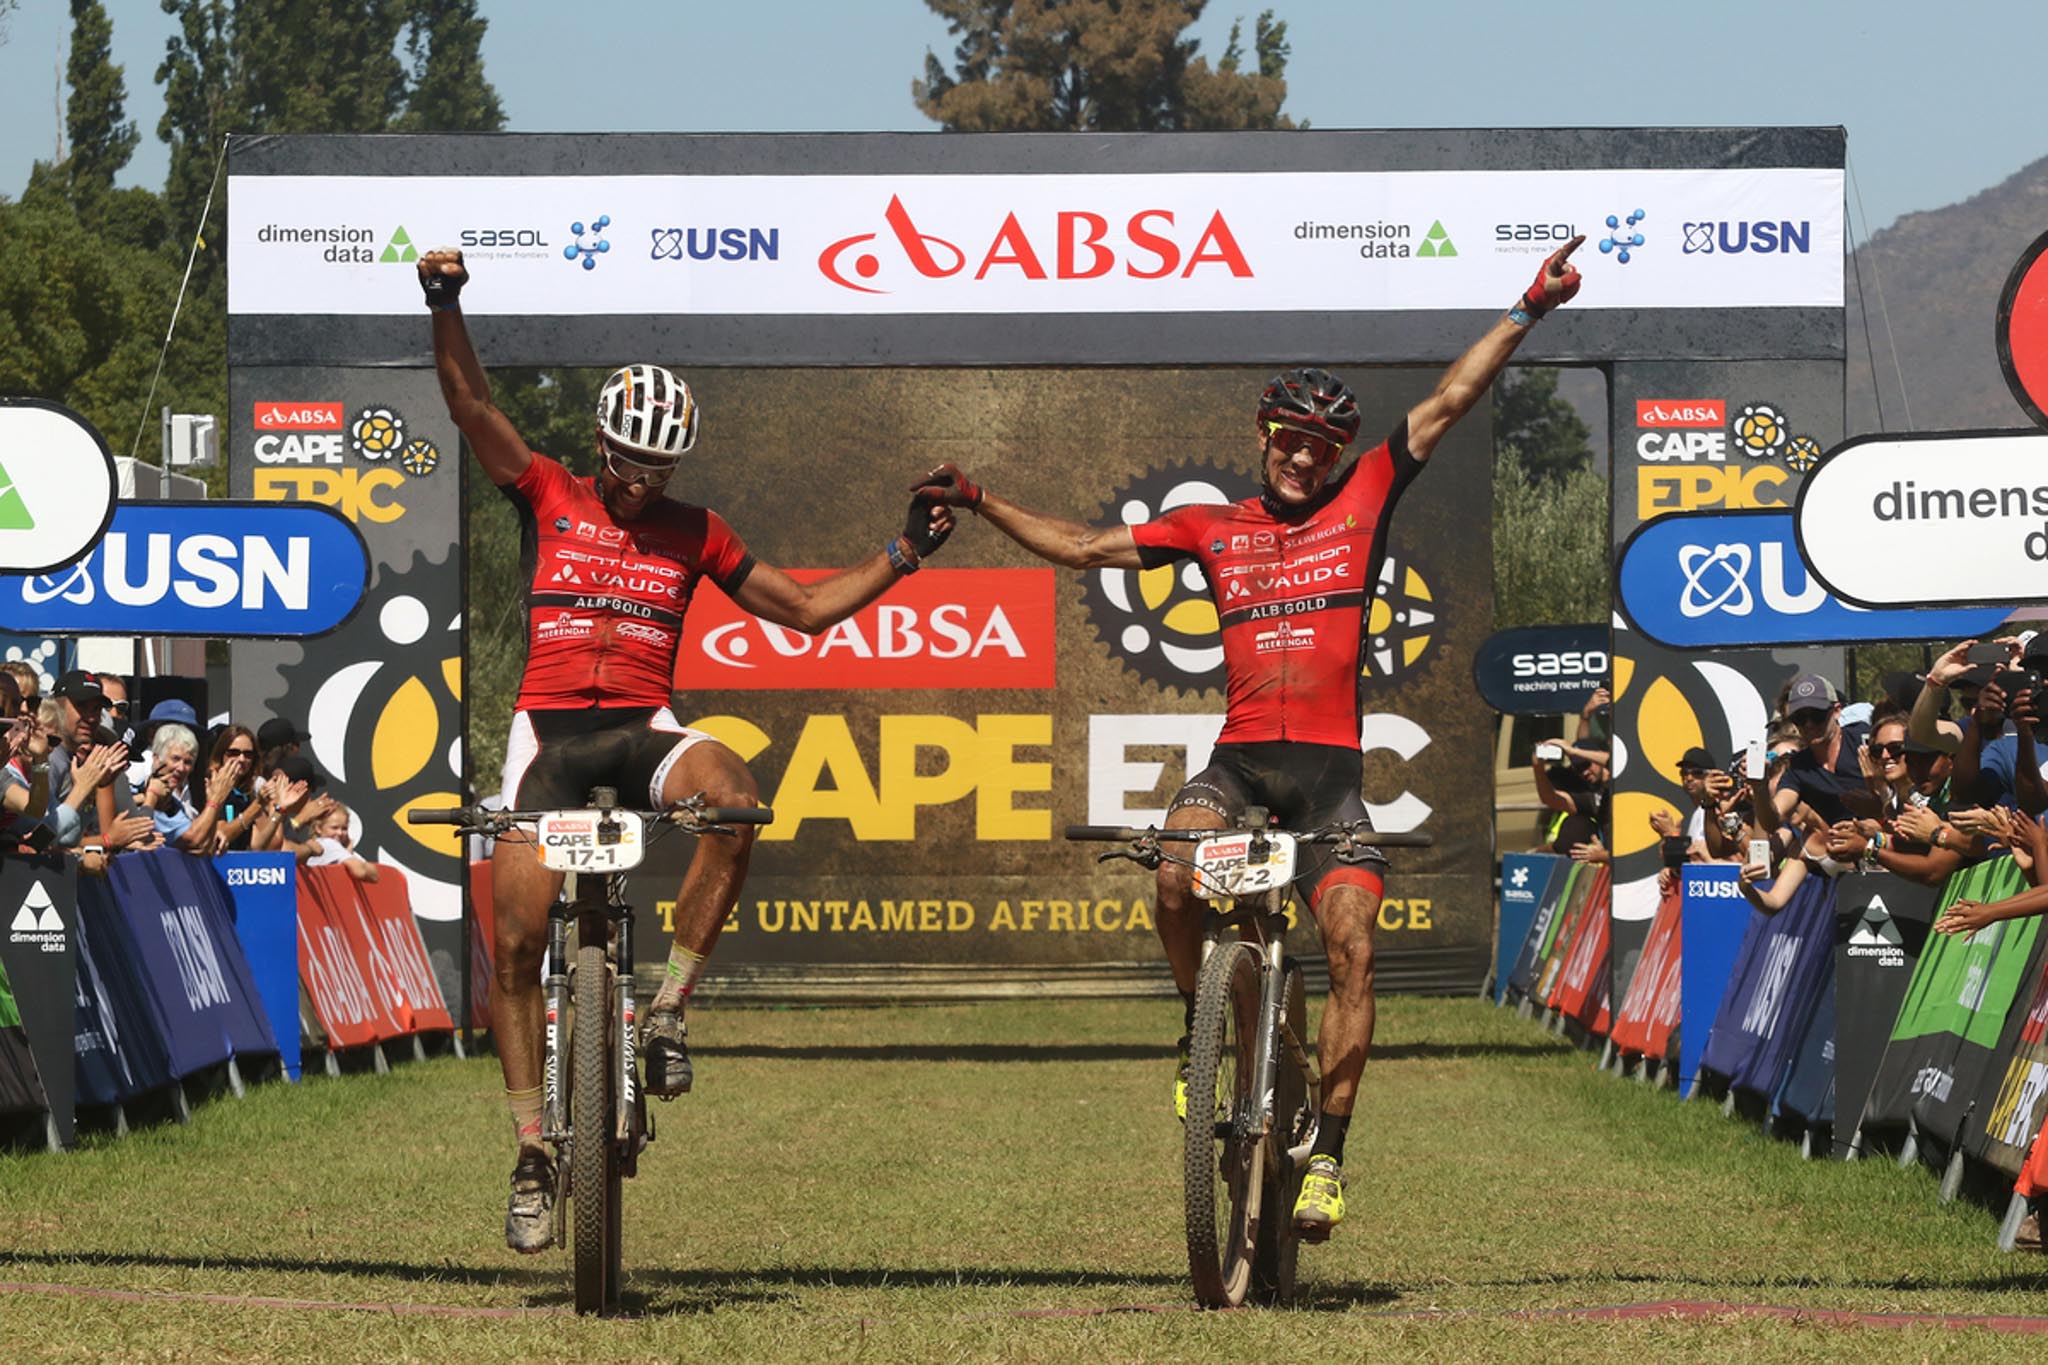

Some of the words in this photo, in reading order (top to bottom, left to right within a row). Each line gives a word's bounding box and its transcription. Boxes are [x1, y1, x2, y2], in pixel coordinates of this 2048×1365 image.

[258, 224, 374, 243] dimension
[1294, 218, 1411, 240] dimension
[1718, 221, 1811, 254] USN
[323, 244, 374, 264] data
[463, 250, 494, 261] eaching
[686, 228, 780, 261] USN
[973, 208, 1255, 281] ABSA
[1360, 240, 1411, 259] data
[287, 409, 338, 424] ABSA
[1669, 406, 1720, 422] ABSA
[254, 434, 344, 465] CAPE
[1636, 432, 1727, 462] CAPE
[254, 467, 407, 524] EPIC
[1637, 465, 1790, 521] EPIC
[103, 531, 310, 611] USN
[555, 549, 687, 581] CENTURION
[1219, 544, 1352, 578] CENTURION
[590, 571, 681, 600] VAUDE
[1256, 562, 1350, 591] VAUDE
[817, 603, 1027, 659] ABSA
[1512, 651, 1607, 677] saso
[1513, 680, 1558, 692] reaching
[1559, 680, 1581, 689] new
[1088, 712, 1433, 834] EC
[546, 834, 592, 847] CAPE
[566, 847, 615, 866] 17-1
[1202, 857, 1246, 873] CAPE
[244, 868, 286, 885] USN
[1217, 868, 1271, 890] 17-2
[1704, 880, 1746, 899] USN
[756, 900, 976, 933] UNTAMED
[988, 899, 1154, 932] AFRICA
[10, 931, 66, 943] dimension
[41, 941, 66, 952] data
[1847, 946, 1904, 957] dimension
[1878, 956, 1904, 967] data
[546, 1024, 558, 1051] DT
[623, 1023, 636, 1073] SWISS
[546, 1055, 558, 1102] SWISS
[623, 1073, 636, 1104] DT
